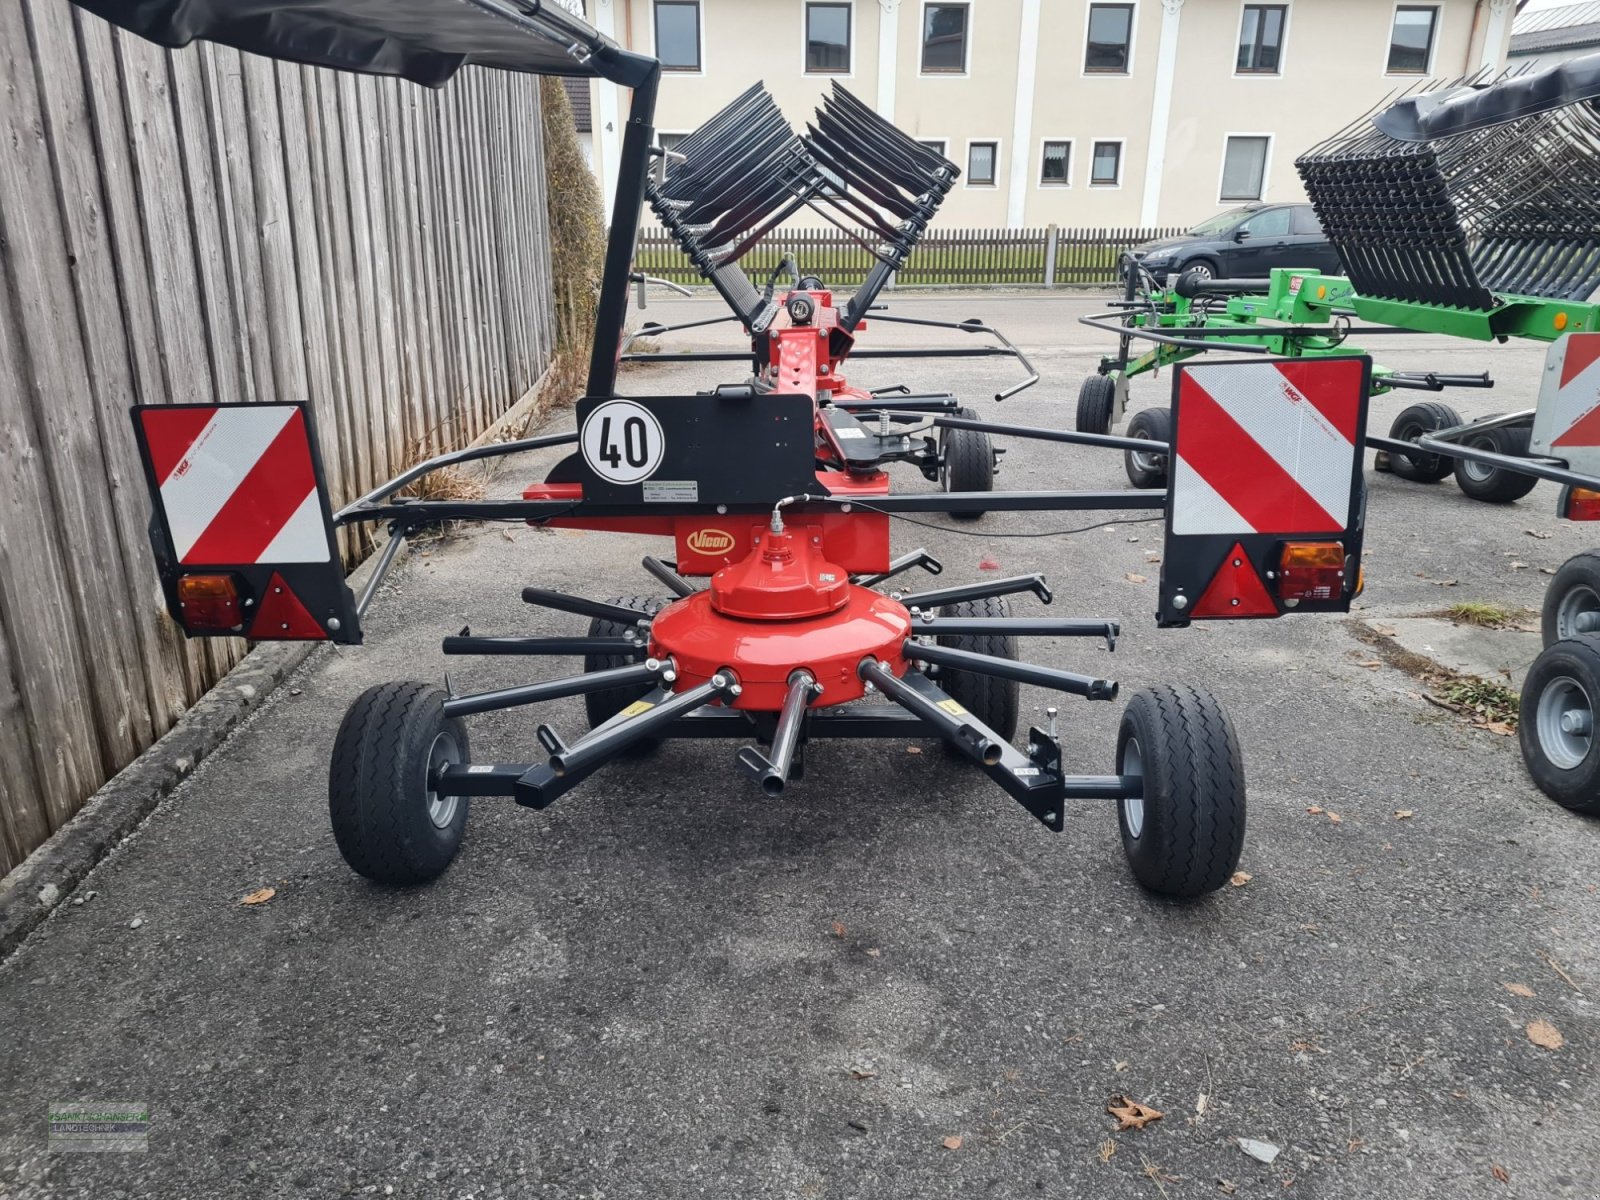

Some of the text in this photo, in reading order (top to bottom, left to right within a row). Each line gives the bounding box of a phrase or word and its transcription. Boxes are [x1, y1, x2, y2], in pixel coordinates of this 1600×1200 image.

[605, 121, 613, 132] 4
[599, 416, 649, 469] 40
[693, 531, 729, 548] Vicon
